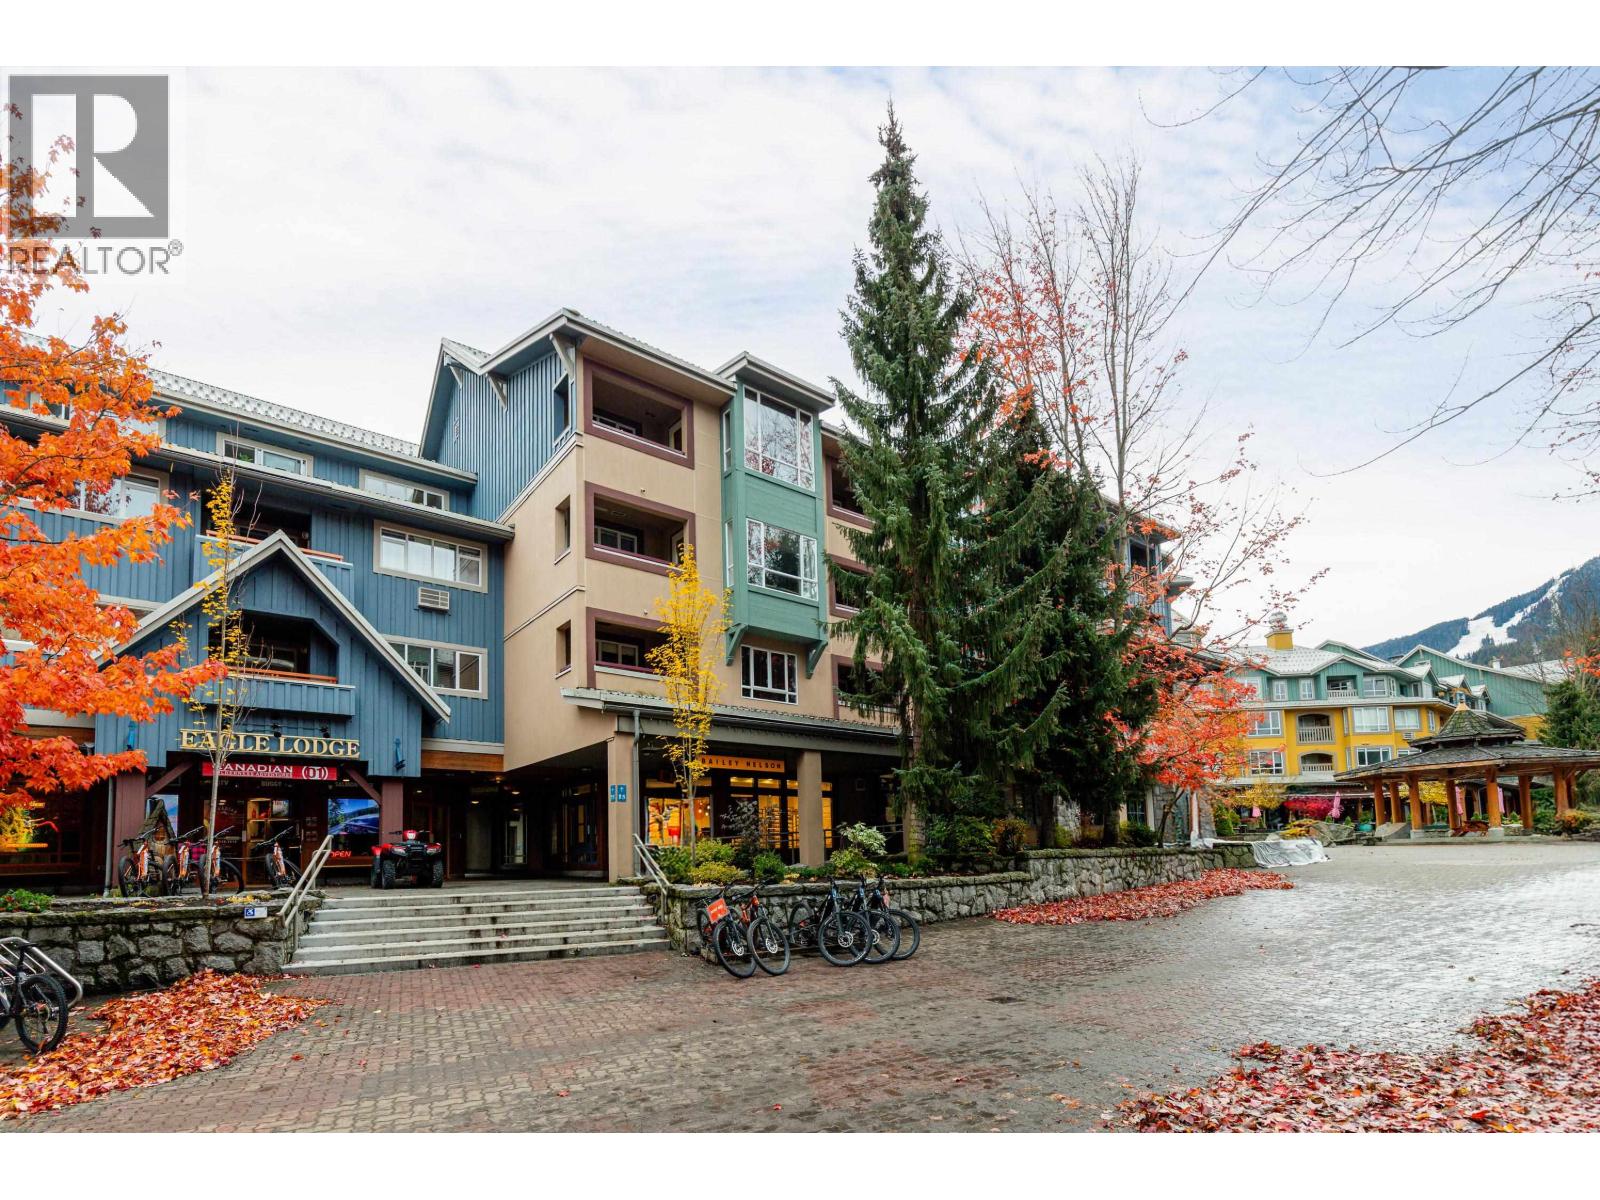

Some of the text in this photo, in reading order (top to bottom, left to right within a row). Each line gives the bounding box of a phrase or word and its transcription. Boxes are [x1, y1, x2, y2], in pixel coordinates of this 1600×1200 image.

[279, 736, 360, 758] LODGE
[701, 757, 781, 769] BAILEY NELSON
